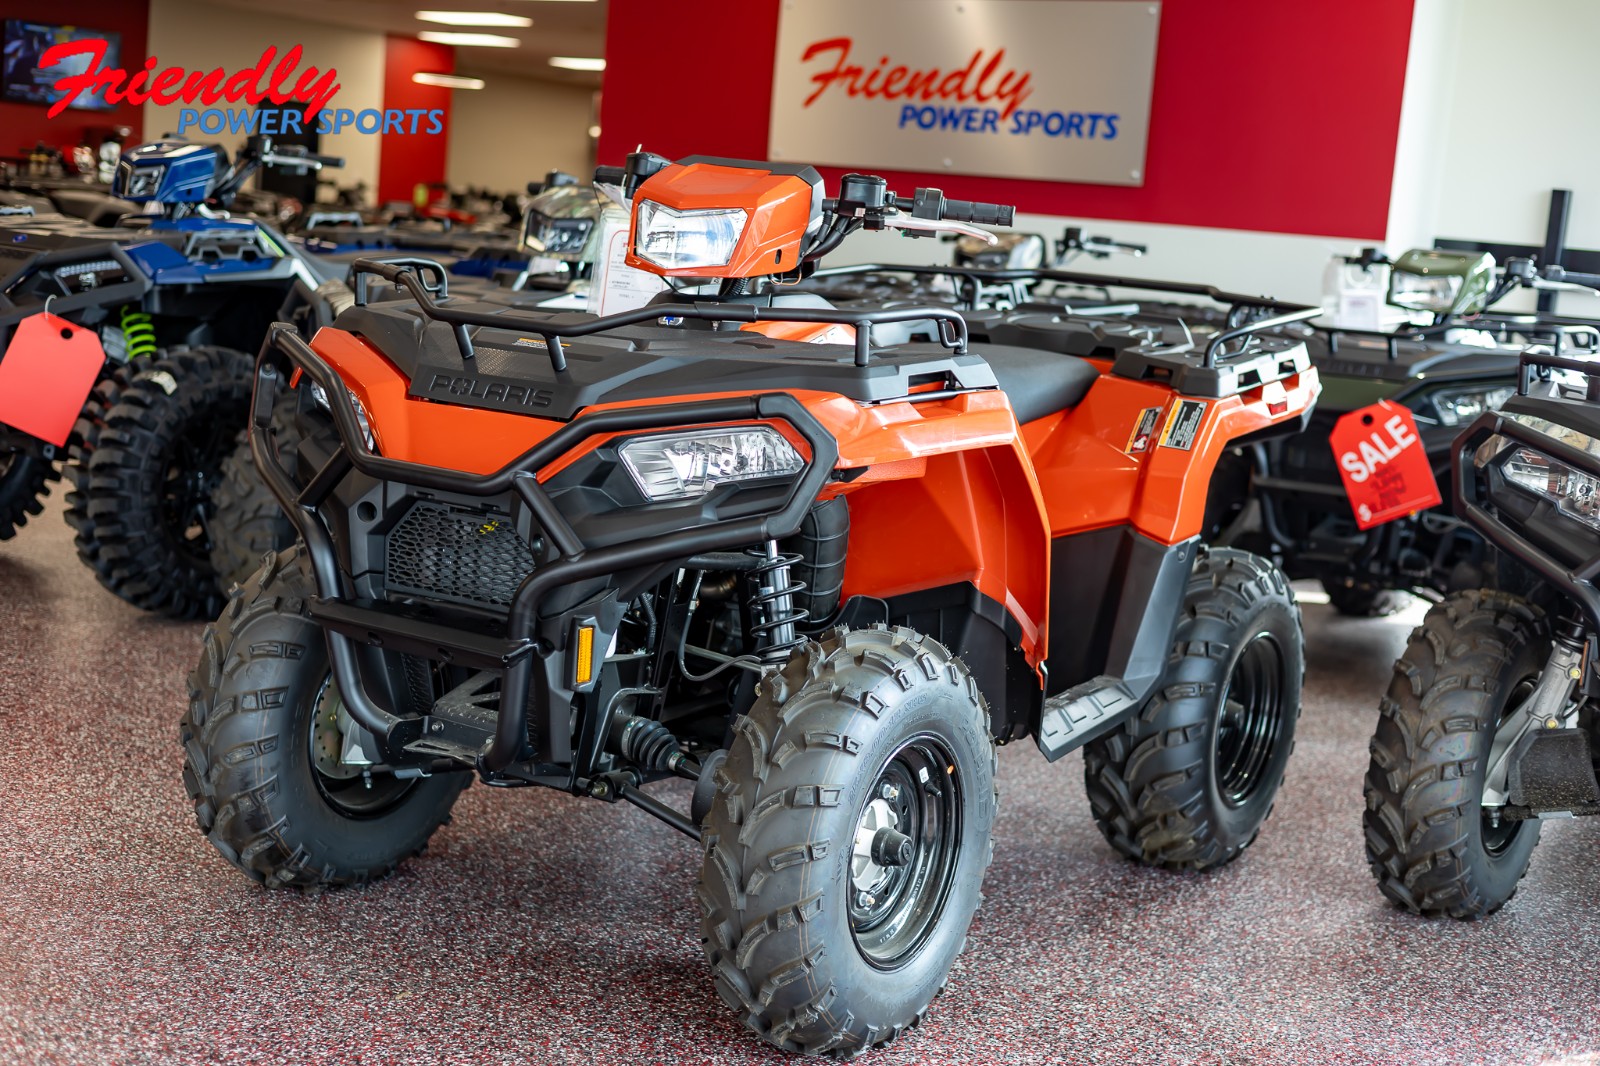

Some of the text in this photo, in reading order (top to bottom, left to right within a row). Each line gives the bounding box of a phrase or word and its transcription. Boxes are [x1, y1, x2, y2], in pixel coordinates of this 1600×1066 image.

[801, 37, 1033, 121] Friendly
[898, 104, 1120, 140] POWER SPORTS
[429, 374, 554, 408] POLARIS
[1341, 415, 1417, 483] SALE
